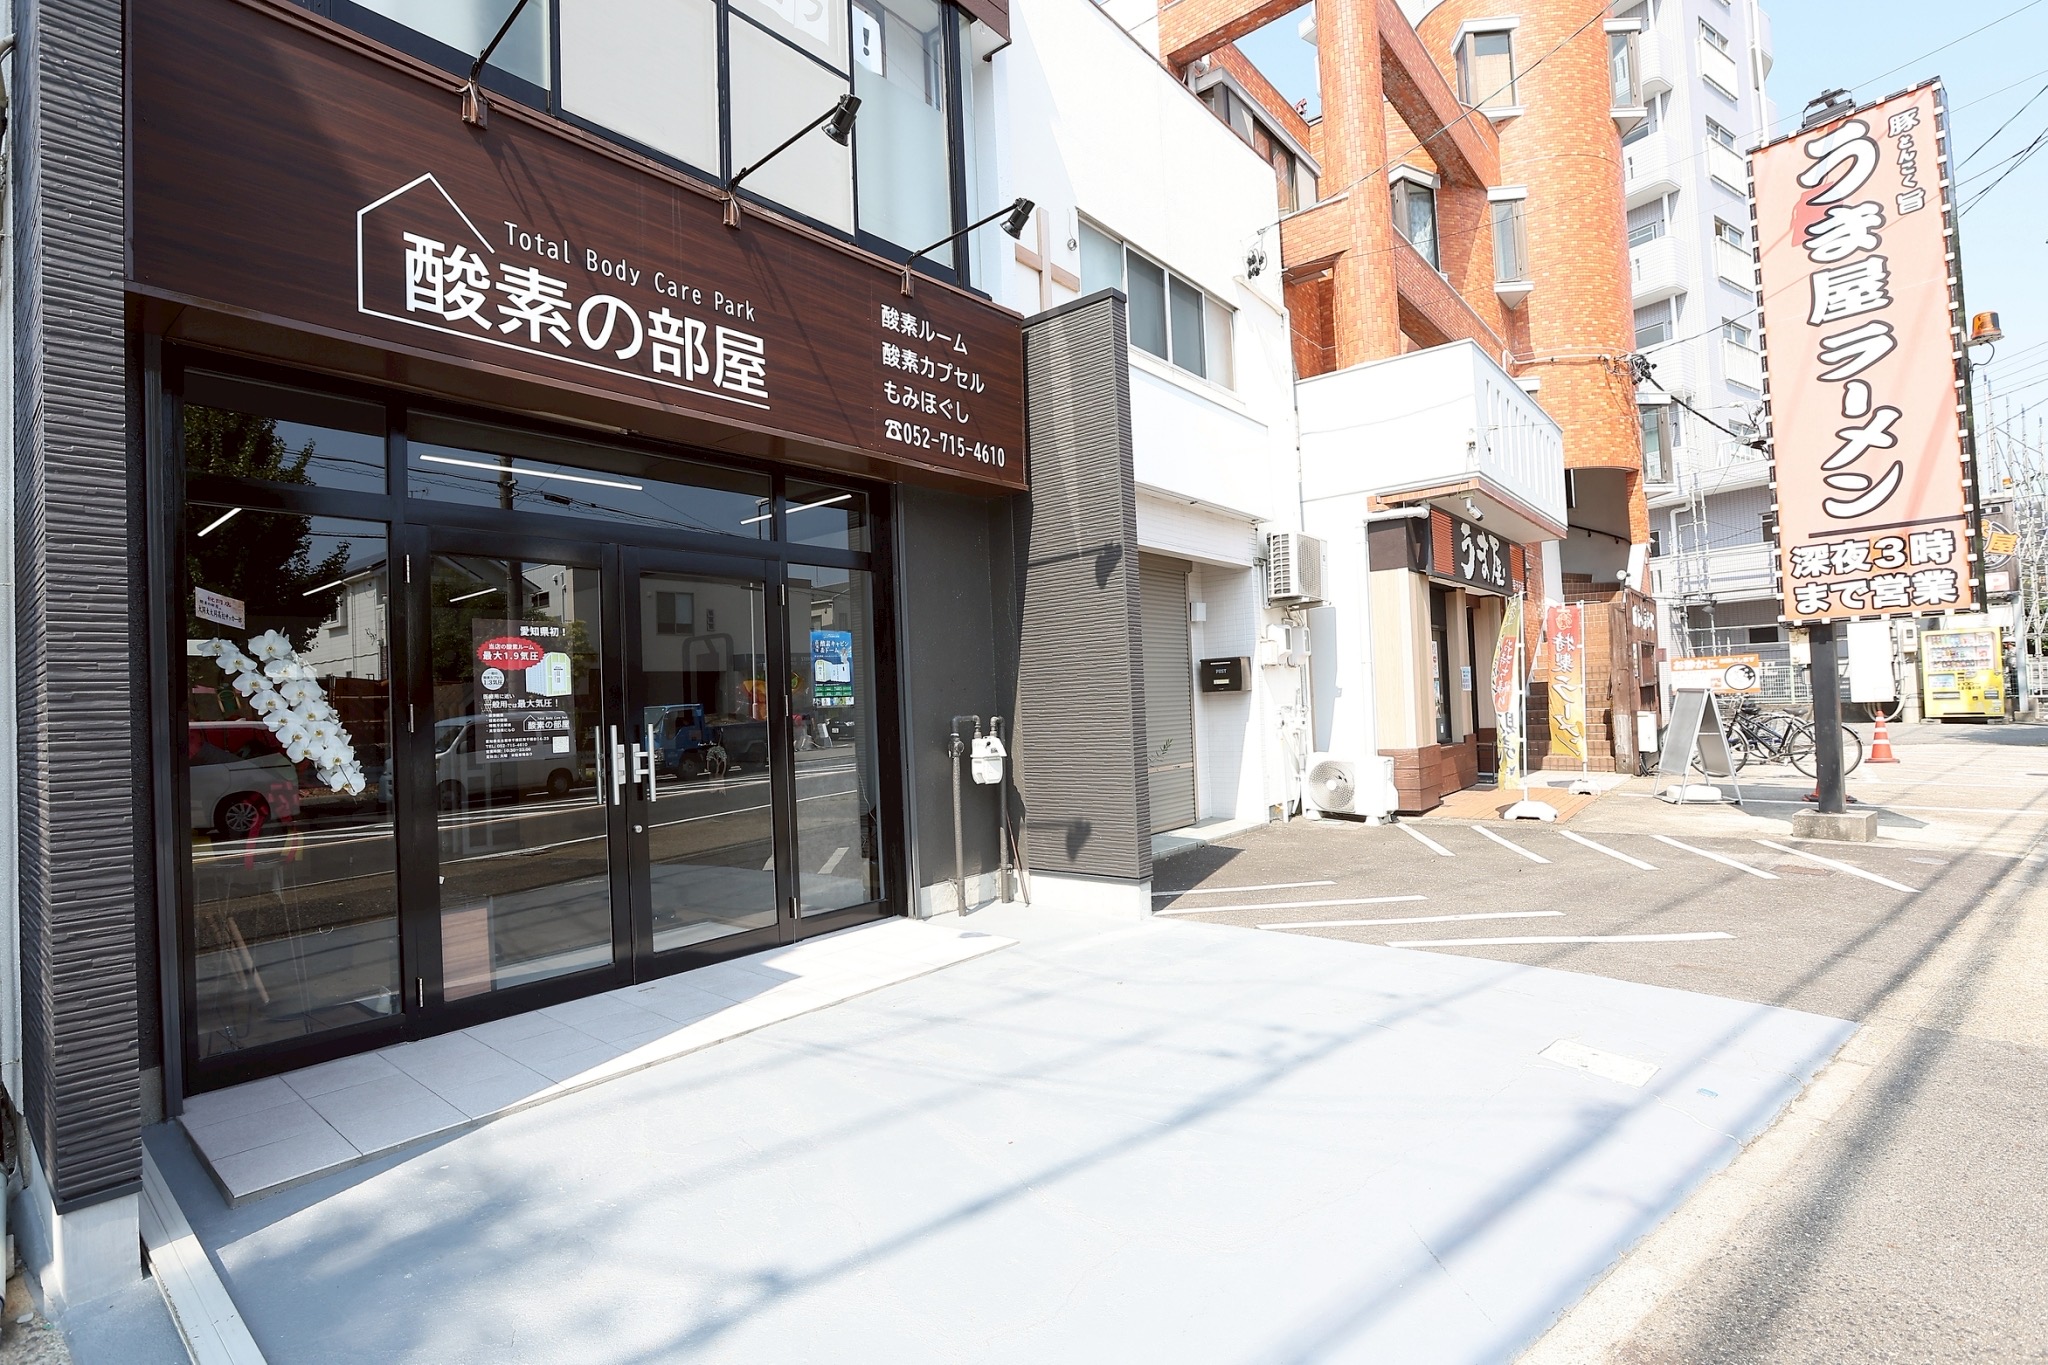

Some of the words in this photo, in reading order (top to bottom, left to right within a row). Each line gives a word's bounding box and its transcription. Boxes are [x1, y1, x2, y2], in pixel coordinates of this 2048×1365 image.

[504, 221, 570, 264] Total
[586, 248, 641, 286] Body
[654, 272, 702, 305] Care
[714, 291, 755, 323] Park
[403, 231, 768, 398] 酸素の部屋
[881, 304, 968, 355] 酸素ルーム
[1797, 119, 1903, 519] うま屋ラーメン
[881, 341, 985, 394] 酸素カプセル
[883, 381, 969, 423] もみほぐし
[903, 422, 1006, 467] 052-715-4610
[1790, 529, 1956, 579] 深夜3時
[1794, 570, 1959, 614] まで営業
[482, 651, 539, 660] 最大1.9気圧
